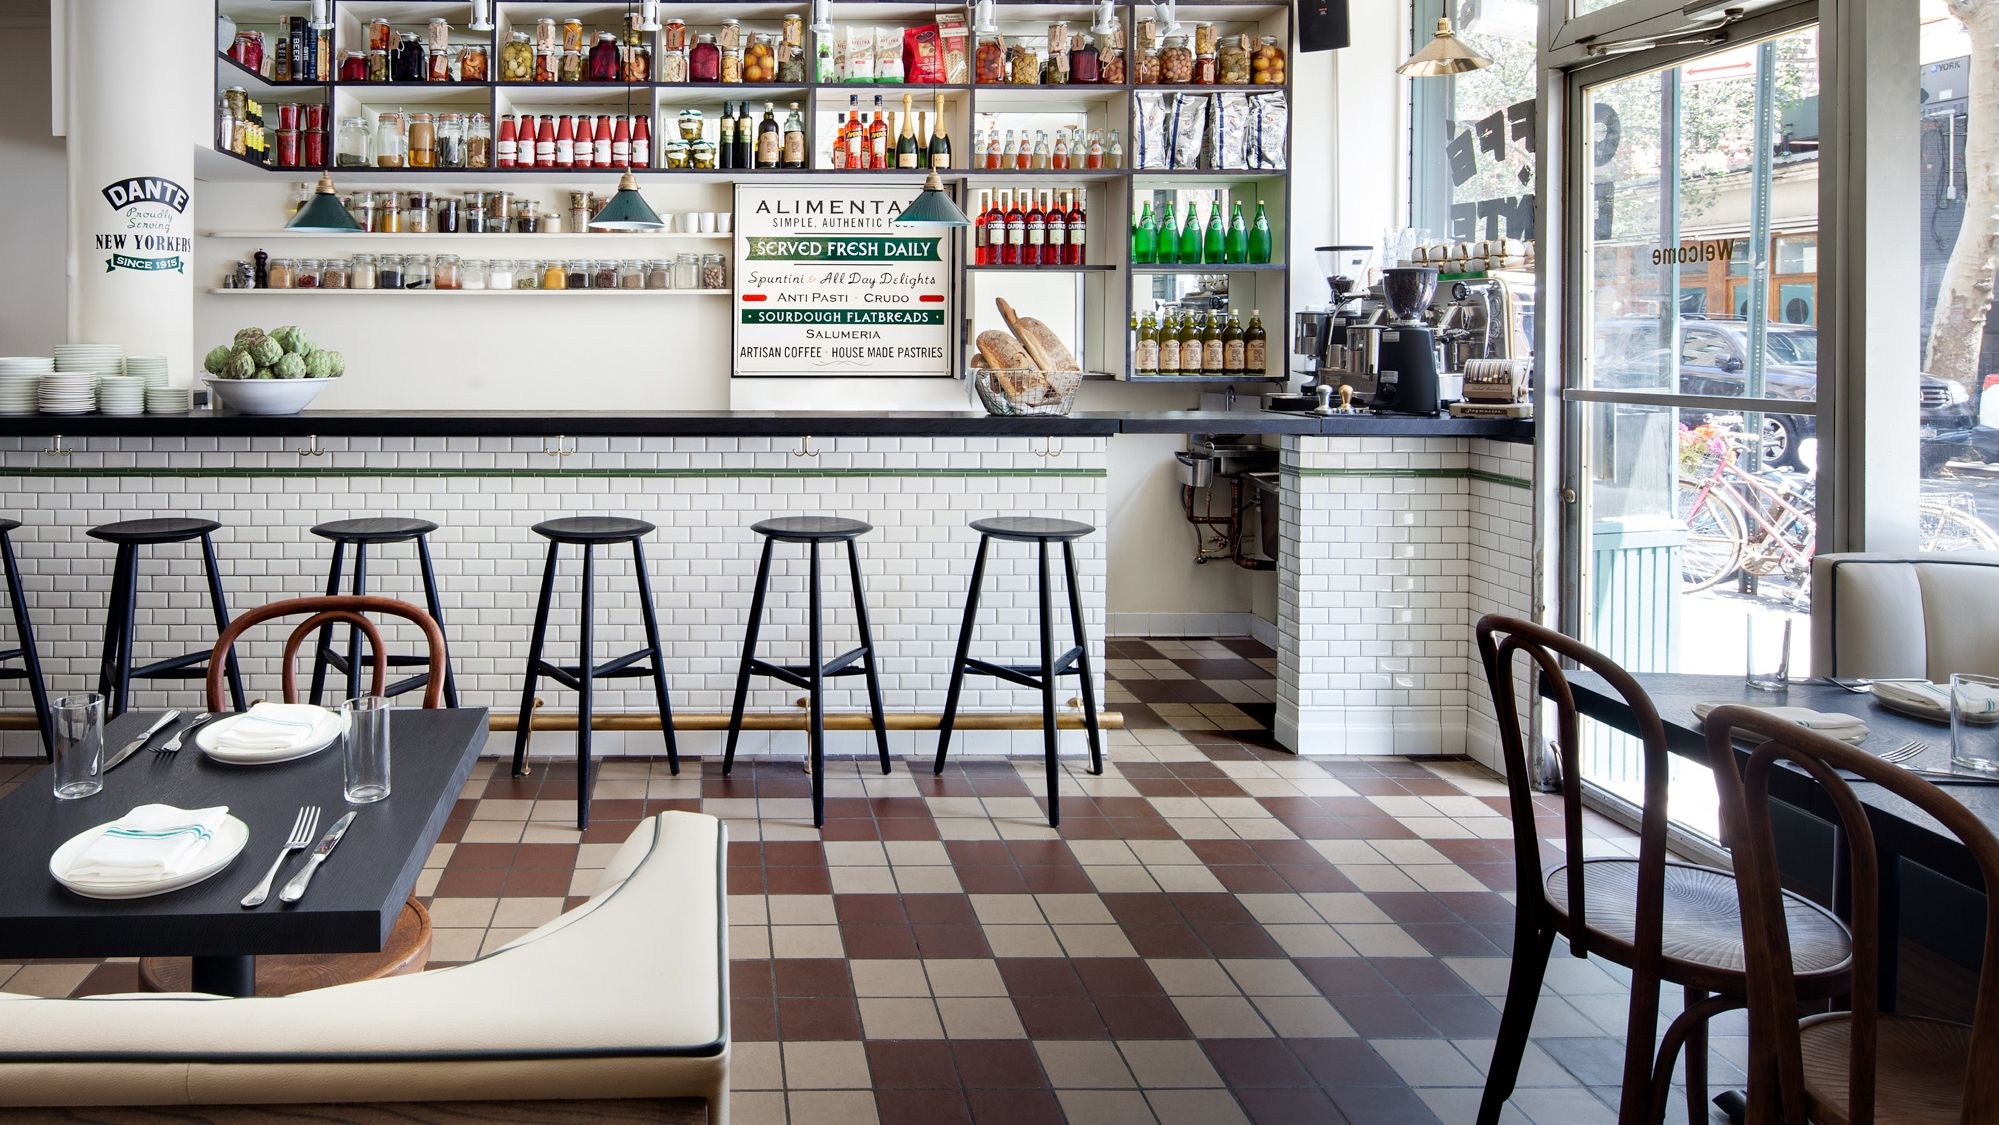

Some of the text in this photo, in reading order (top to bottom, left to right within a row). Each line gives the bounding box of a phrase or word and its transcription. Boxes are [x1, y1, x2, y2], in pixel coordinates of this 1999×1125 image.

[1939, 61, 1961, 72] YORK
[107, 179, 187, 212] DANTE
[126, 207, 174, 222] Proudly
[756, 200, 915, 215] ALIMENTA
[127, 218, 171, 233] Serving
[773, 217, 817, 228] SIMPLE,
[822, 218, 882, 228] AUTHENTIC
[96, 234, 191, 253] NEW YORKERS
[758, 241, 931, 256] SERVED FRESH DAILY
[116, 256, 177, 269] SINCE 1915
[748, 271, 805, 288] Spuntini
[820, 272, 845, 285] All
[848, 273, 876, 288] Day
[879, 272, 936, 289] Delights
[777, 292, 910, 303] ANTI PASTI CRUDO
[758, 311, 929, 323] SOURDOUGH FLATBREADS
[806, 329, 881, 340] SALUMERIA
[740, 347, 943, 358] ARTISAN COFFEE HOUSE MADE PASTRIES
